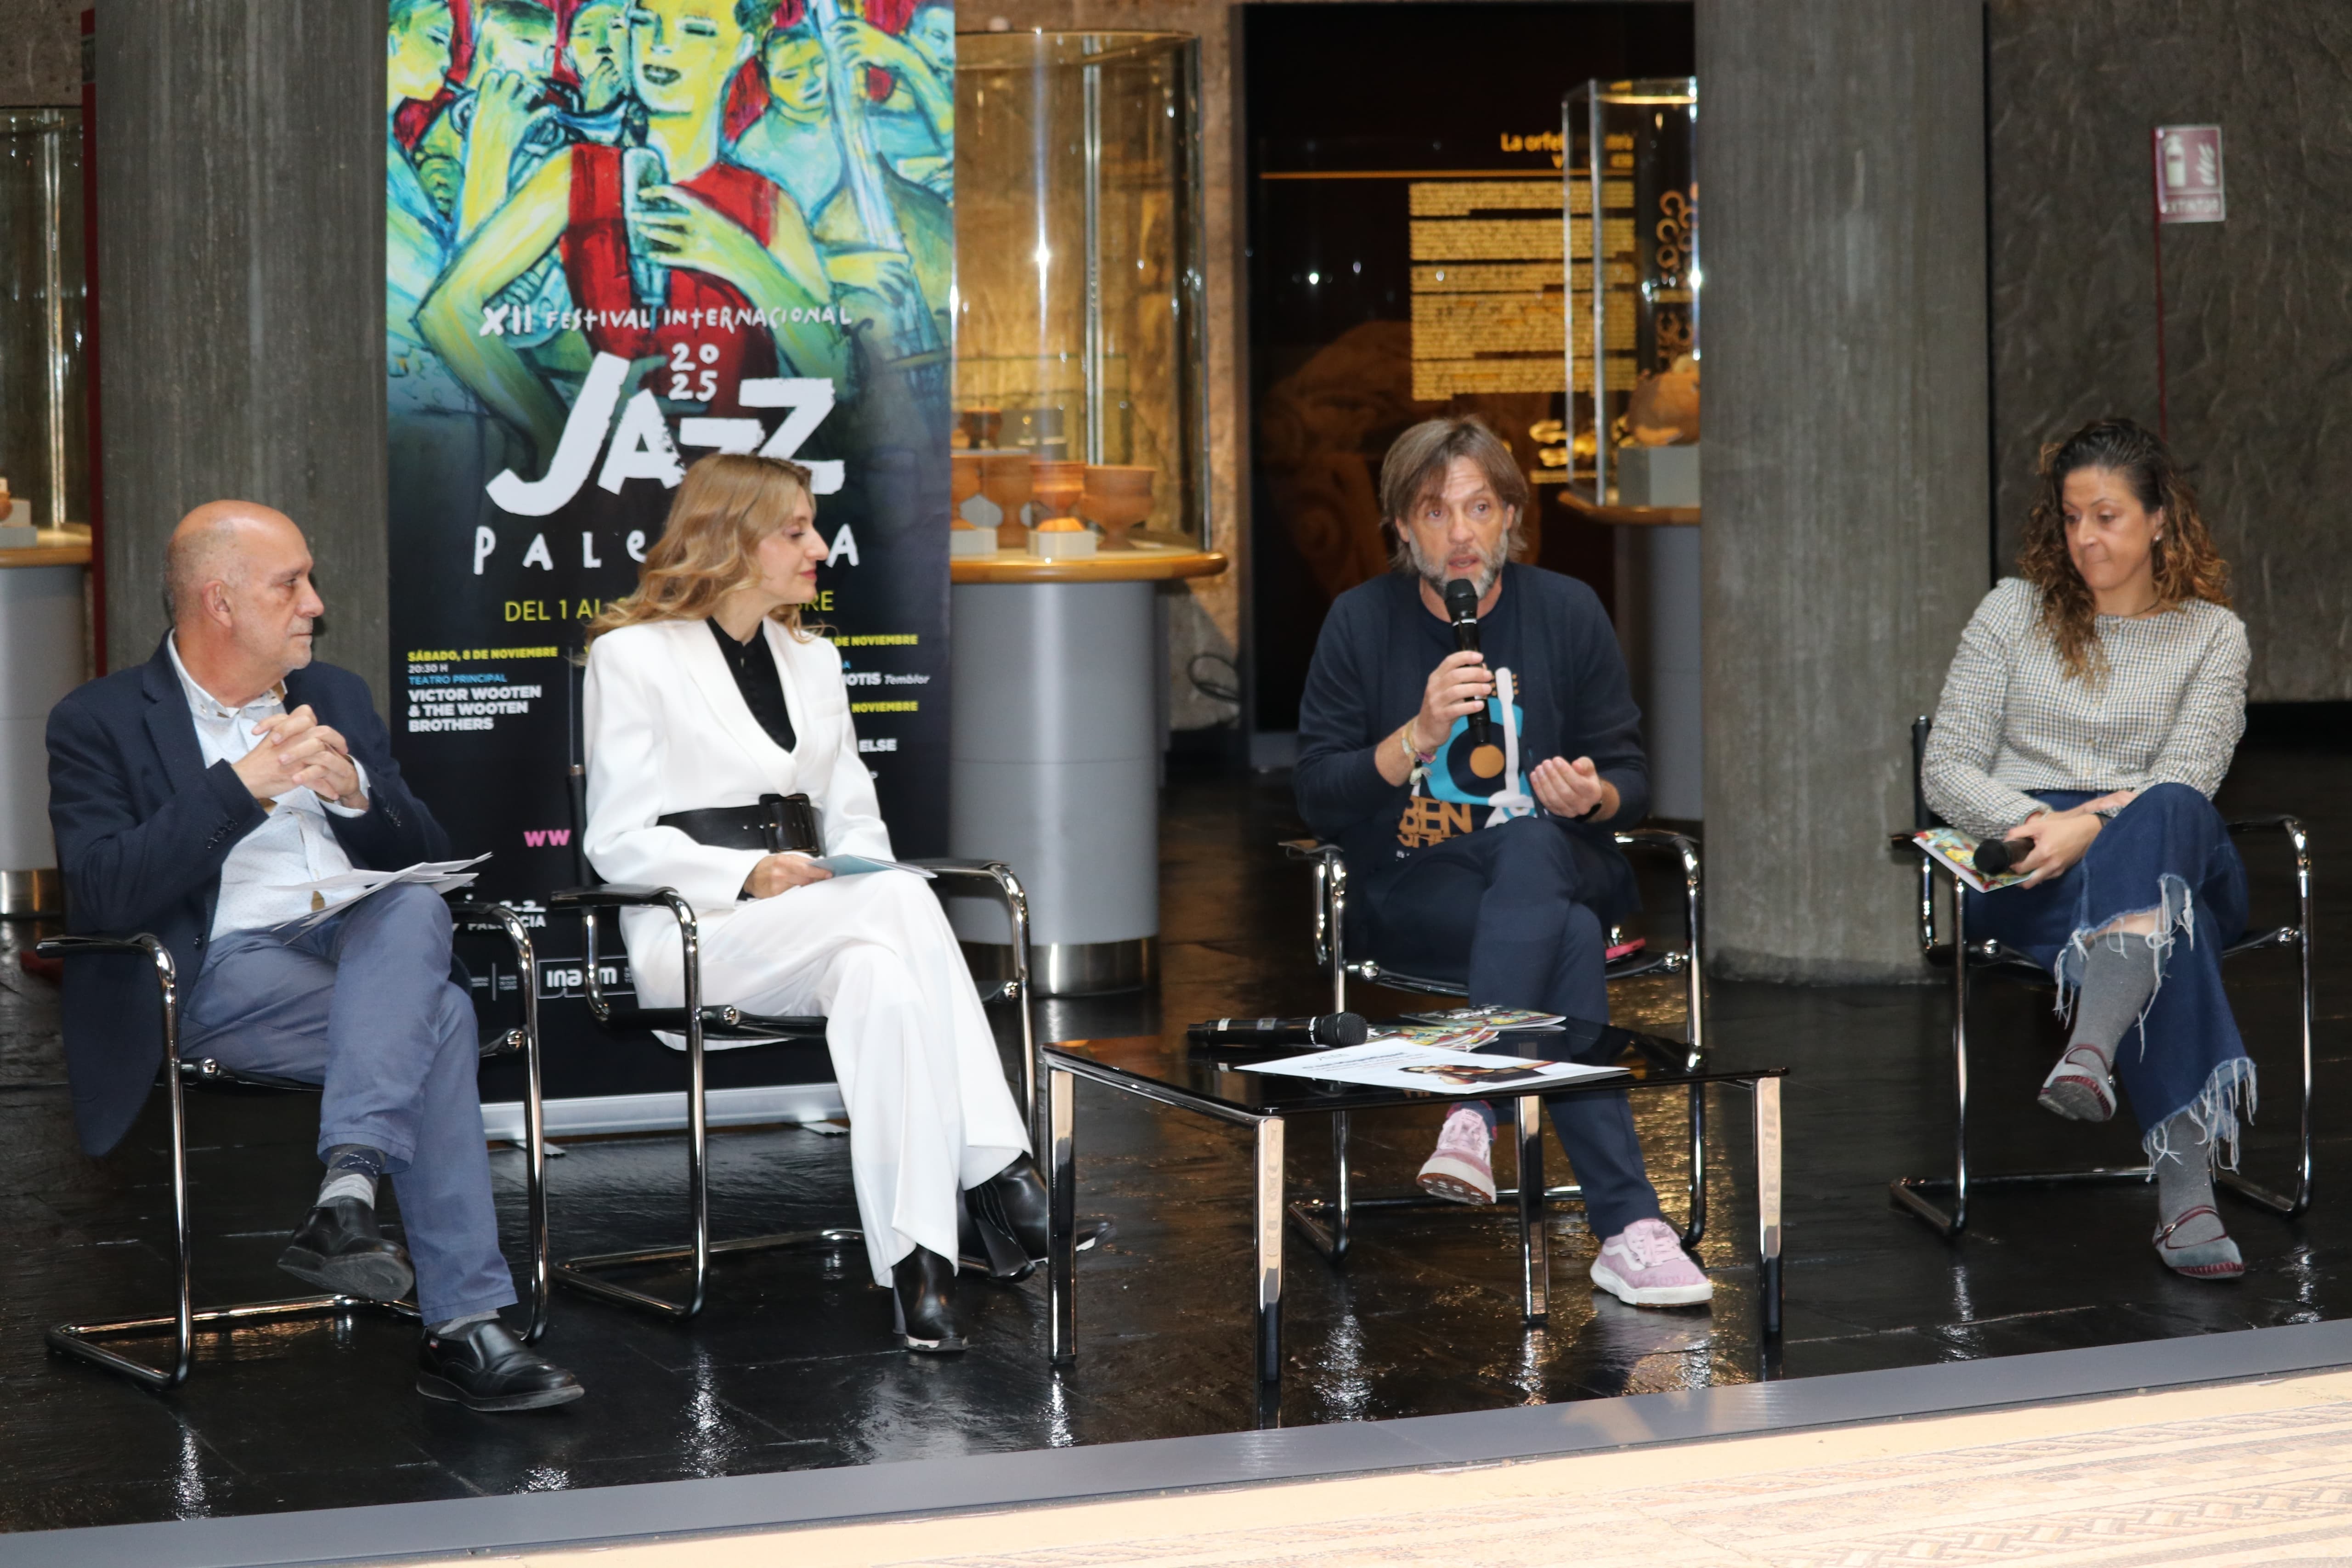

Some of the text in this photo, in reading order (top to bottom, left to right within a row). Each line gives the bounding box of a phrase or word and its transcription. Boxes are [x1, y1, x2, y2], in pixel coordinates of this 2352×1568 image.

[480, 304, 852, 337] XII FESTIVAL INTERNACIONAL
[670, 343, 719, 372] 20
[669, 370, 718, 402] 25
[505, 600, 551, 622] DEL
[559, 600, 567, 620] 1
[835, 634, 918, 647] DE NOVIEMBRE
[407, 646, 559, 662] SÁBADO, 8 DE NOVIEMBRE
[408, 663, 448, 674] 20:30 H
[408, 673, 507, 685] TEATRO PRINCIPAL
[884, 674, 931, 685] Temblor
[408, 685, 542, 702] VICTOR WOOTEN
[408, 700, 528, 718] & THE WOOTEN
[851, 701, 918, 713] NOVIEMBRE
[408, 717, 494, 733] BROTHERS
[859, 738, 897, 753] ELSE
[546, 967, 617, 988] inam
